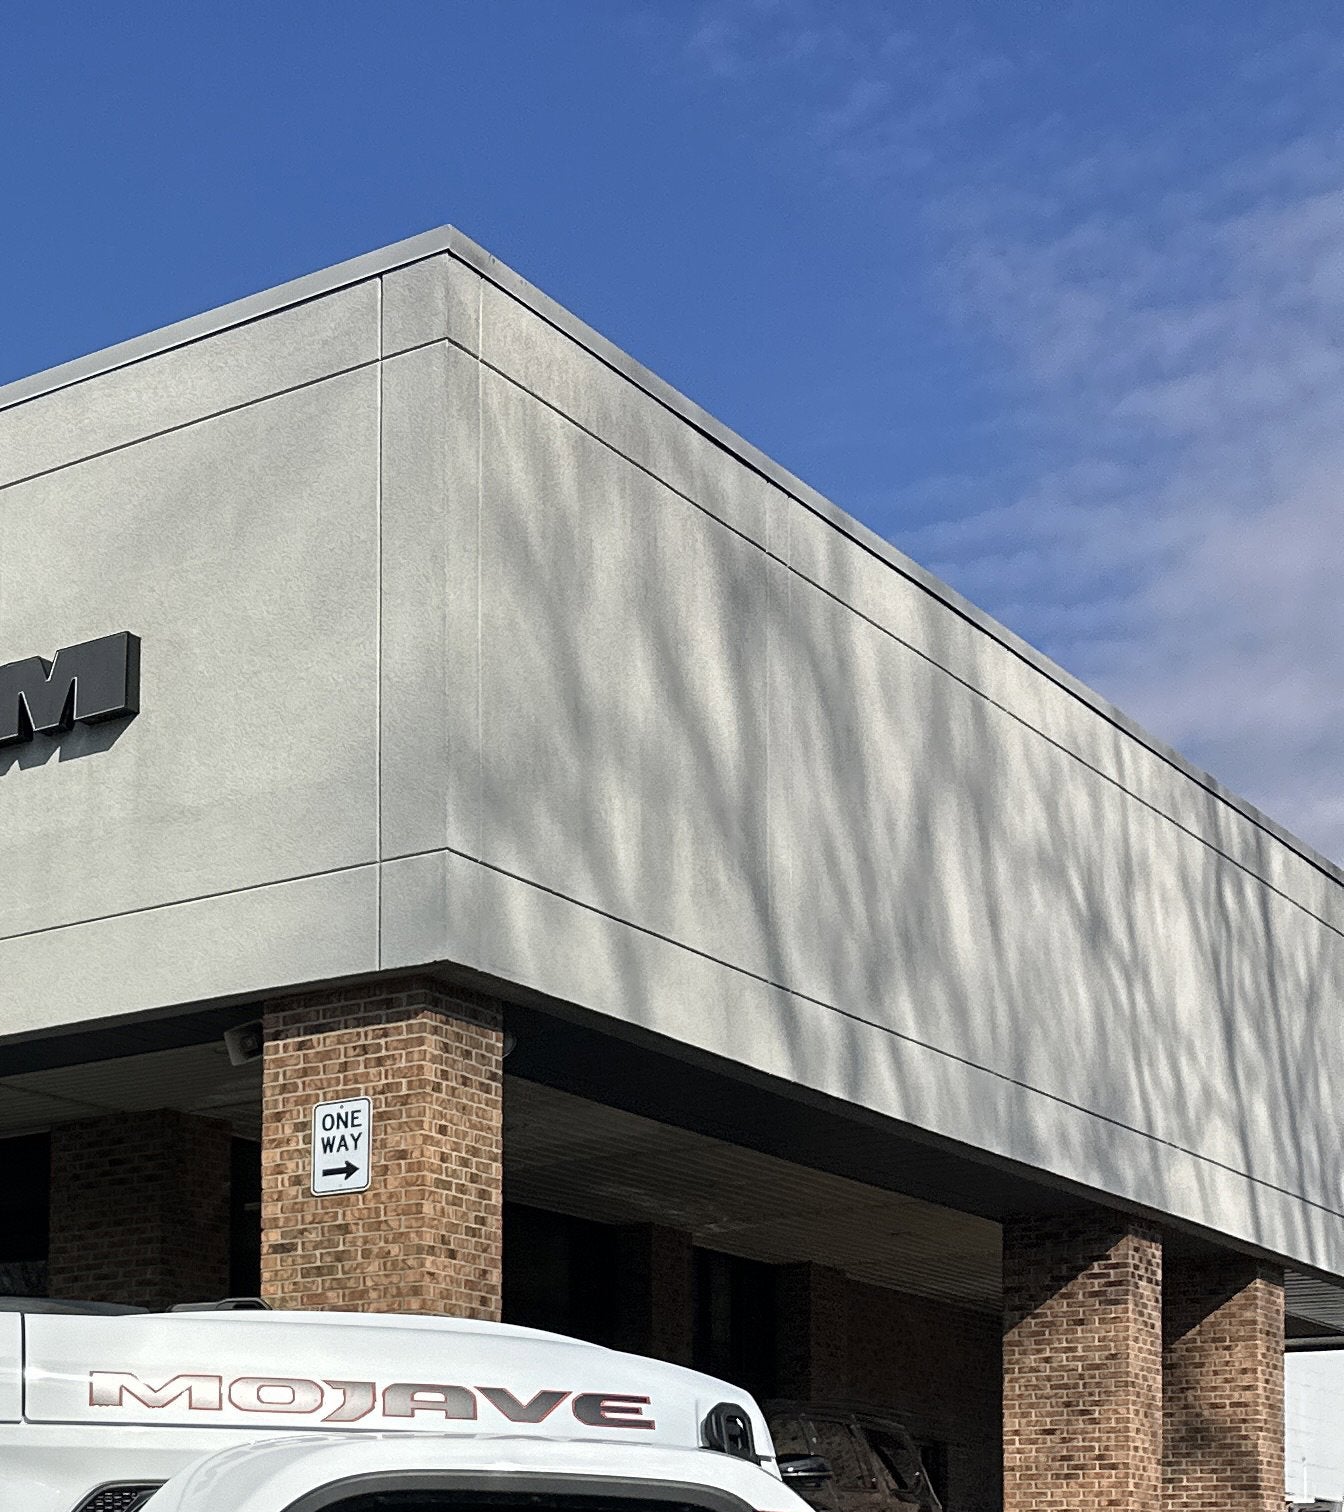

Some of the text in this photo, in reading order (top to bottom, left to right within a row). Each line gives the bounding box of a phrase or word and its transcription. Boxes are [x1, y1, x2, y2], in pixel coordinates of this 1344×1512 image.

[321, 1109, 363, 1131] ONE
[321, 1132, 363, 1154] WAY
[89, 1370, 656, 1430] MOJAVE
